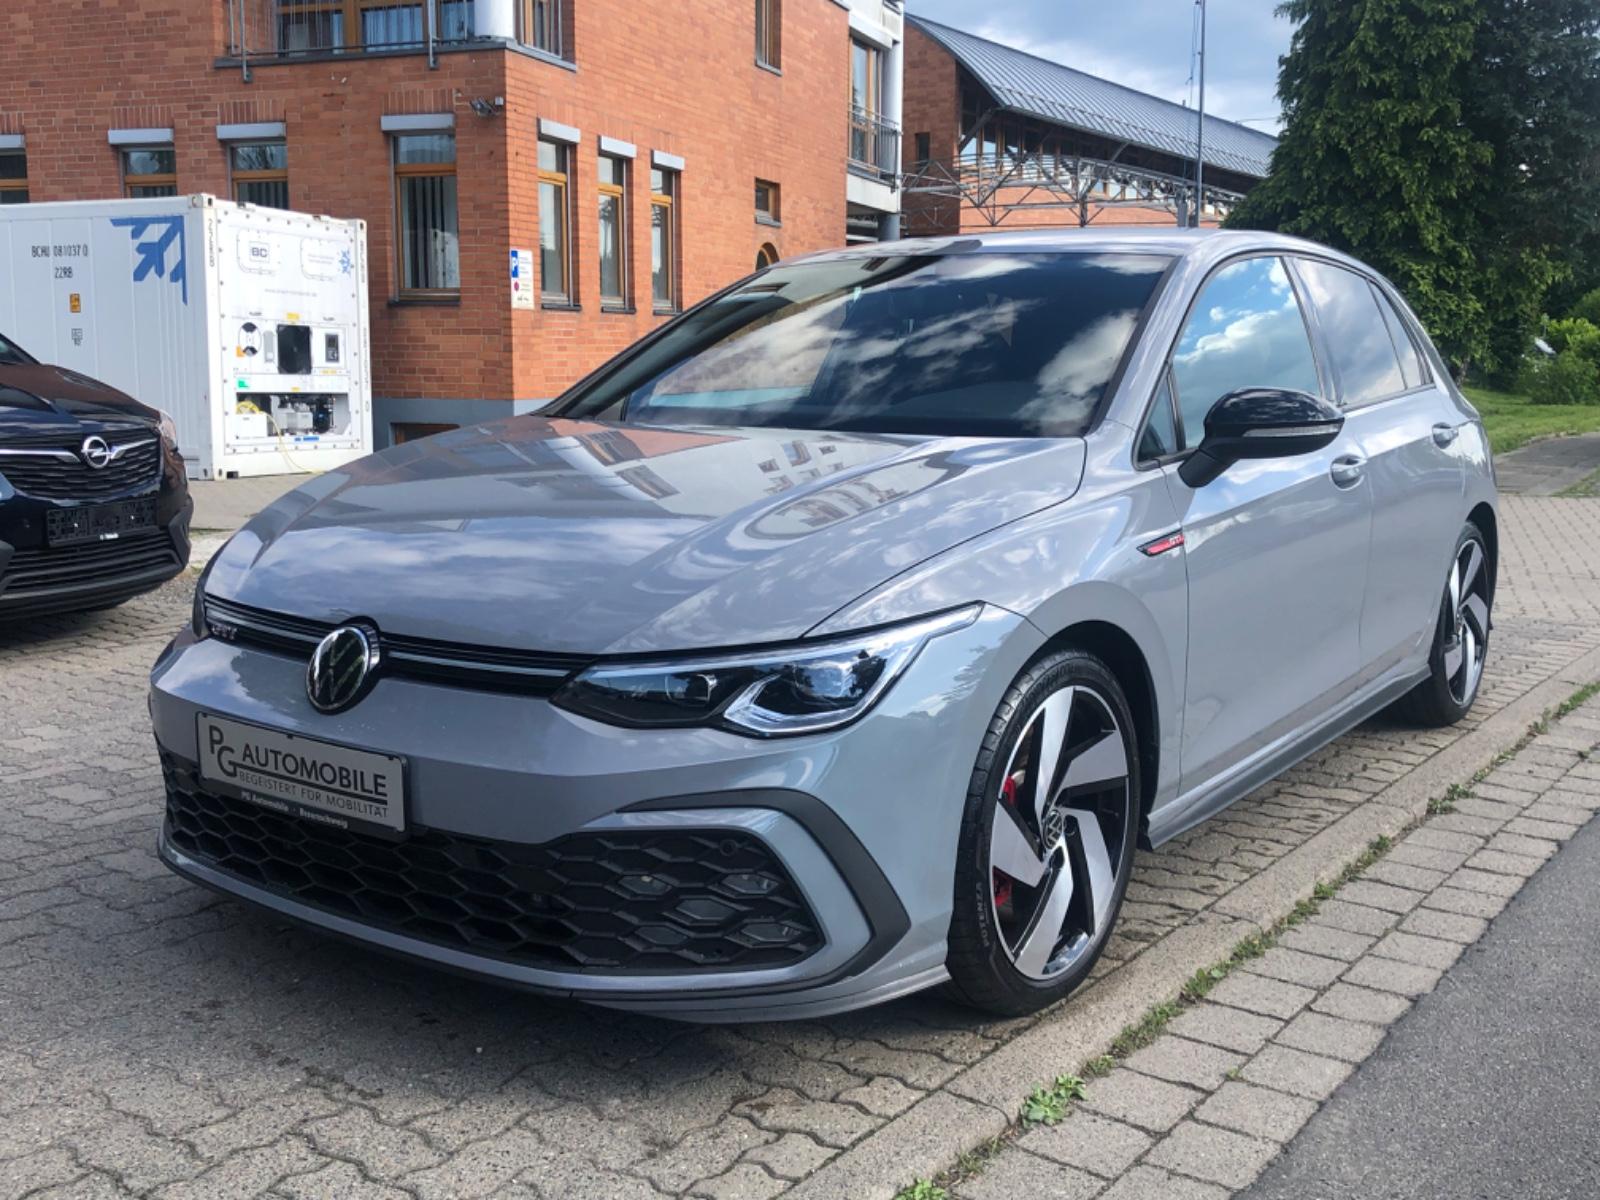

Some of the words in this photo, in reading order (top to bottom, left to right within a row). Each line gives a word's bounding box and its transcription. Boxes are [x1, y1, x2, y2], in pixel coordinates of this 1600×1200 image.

[251, 247, 268, 258] BC
[239, 770, 297, 795] BEGEISTERT
[242, 742, 388, 798] AUTOMOBILE
